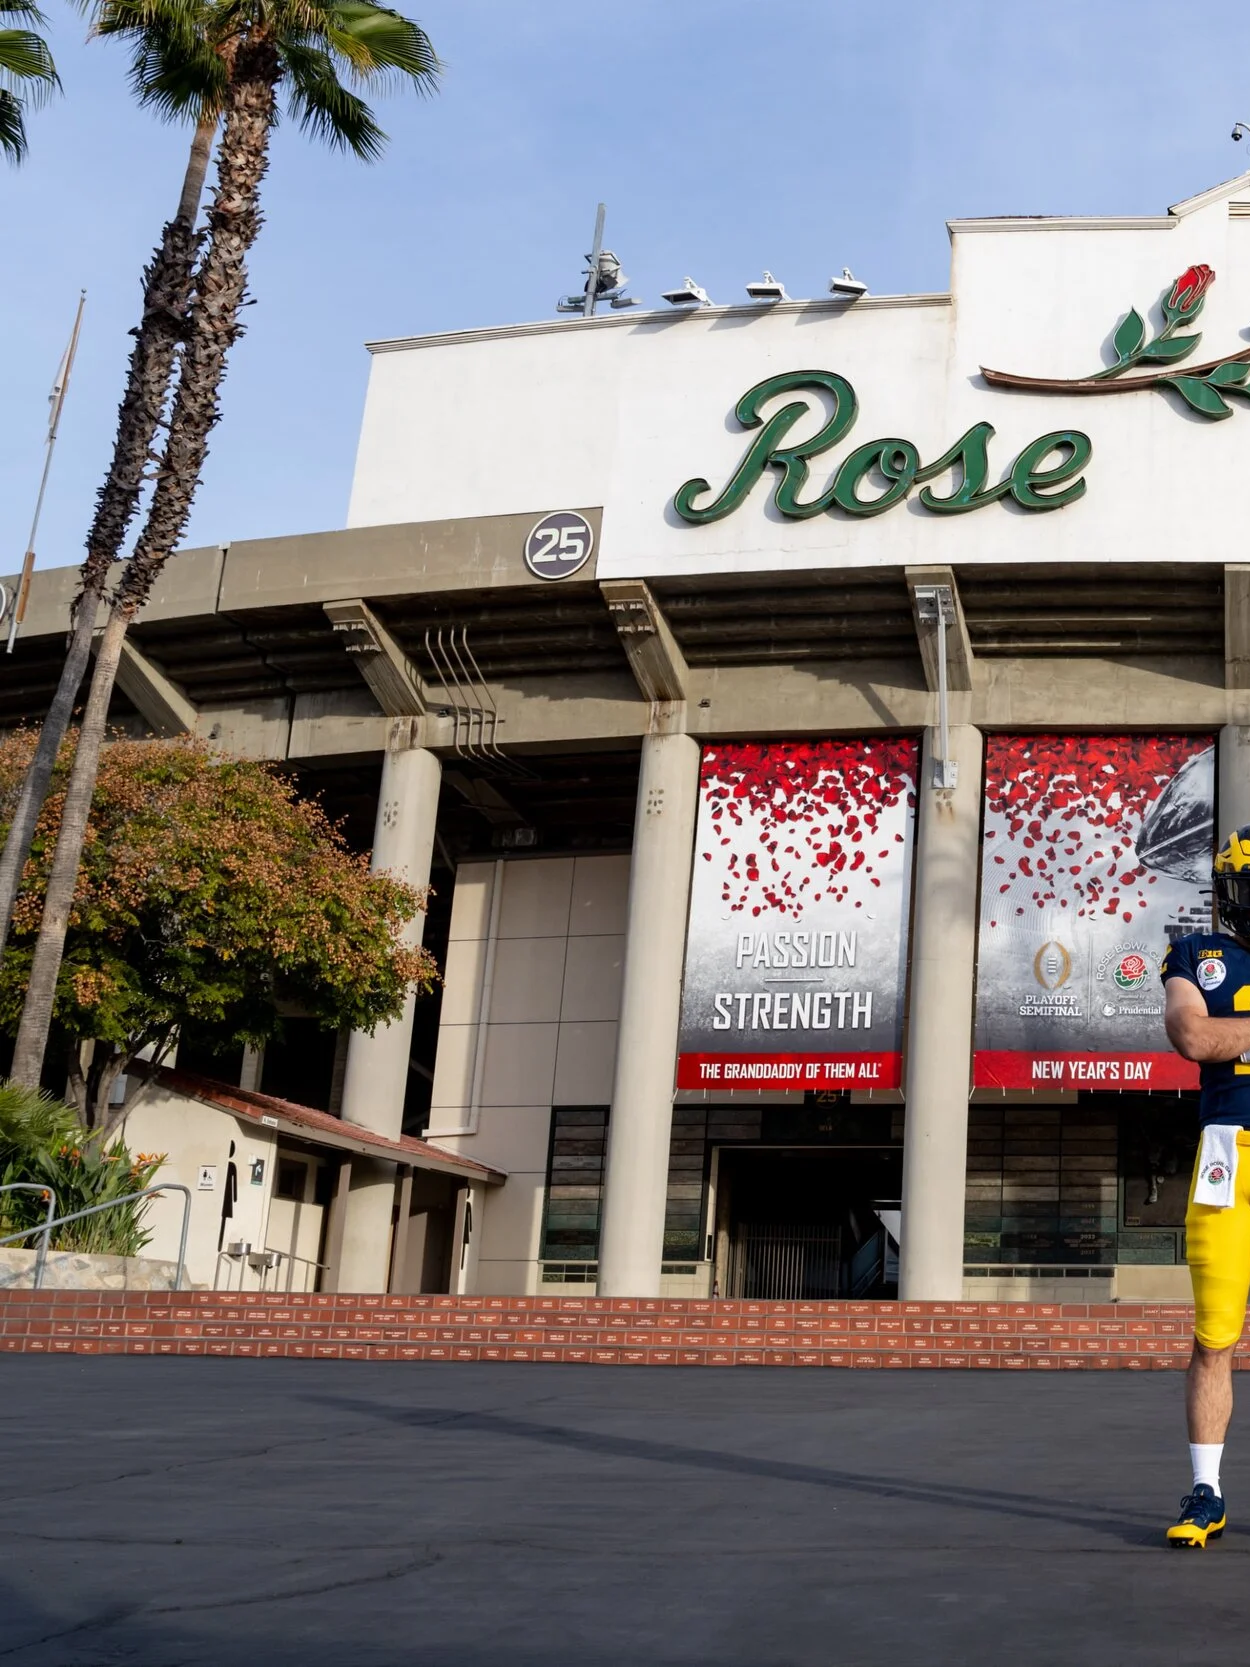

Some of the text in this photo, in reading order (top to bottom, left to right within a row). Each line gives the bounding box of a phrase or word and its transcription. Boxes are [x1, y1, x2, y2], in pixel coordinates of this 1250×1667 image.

[673, 369, 1092, 524] Rose
[531, 525, 586, 563] 25
[736, 931, 857, 968] PASSION
[1025, 995, 1078, 1005] PLAYOFF
[713, 991, 872, 1030] STRENGTH
[1019, 1006, 1082, 1016] SEMIFINAL
[1119, 1006, 1161, 1015] Prudential
[700, 1062, 721, 1078] THE
[724, 1063, 802, 1079] GRANDDADDY
[805, 1063, 820, 1079] OF
[823, 1063, 855, 1078] THEM
[1032, 1060, 1152, 1080] NEW YEAR'S DAY
